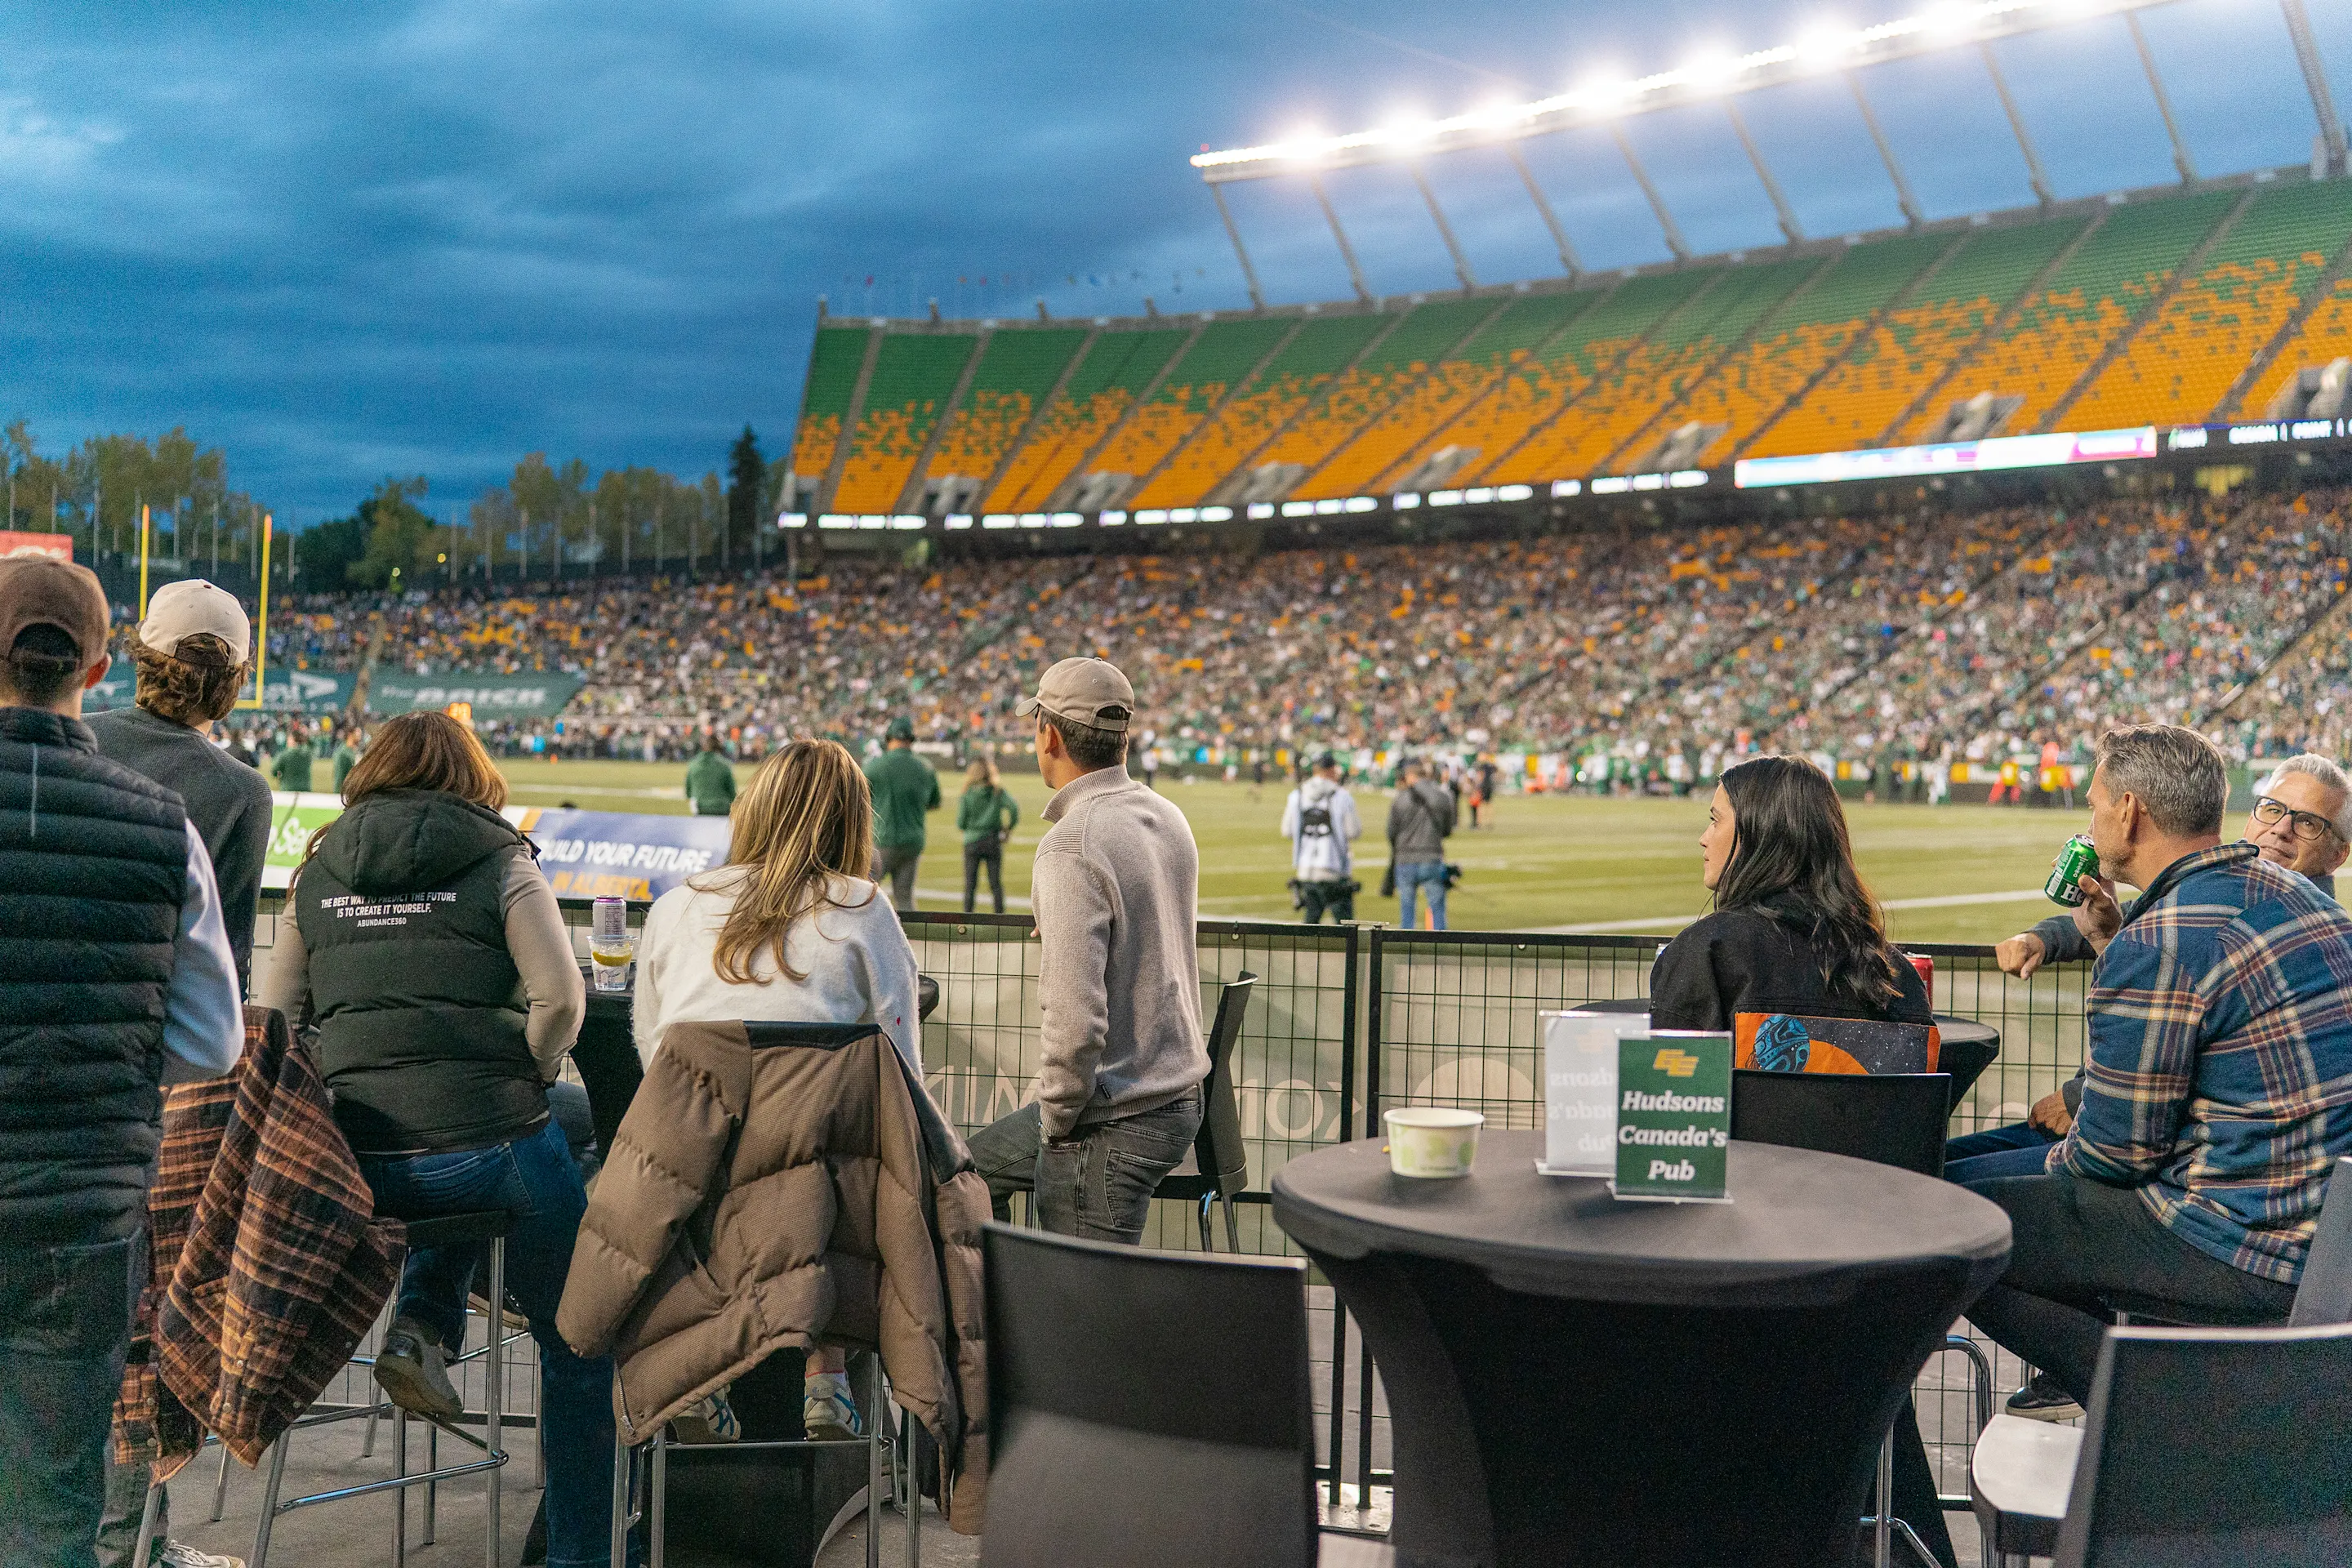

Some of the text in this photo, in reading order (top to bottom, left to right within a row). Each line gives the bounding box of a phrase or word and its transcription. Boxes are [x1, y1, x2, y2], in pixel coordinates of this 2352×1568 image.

[537, 839, 712, 872] BUILD YOUR FUTURE
[321, 892, 457, 909] THE BEST WAY TO PREDICT THE FUTURE
[336, 902, 432, 919] IS TO CREATE IT YOURSELF.
[357, 916, 408, 928] ABUNDANCE360
[1621, 1089, 1726, 1113] Hudsons
[1618, 1125, 1729, 1147] Canada's
[1646, 1158, 1695, 1182] Pub
